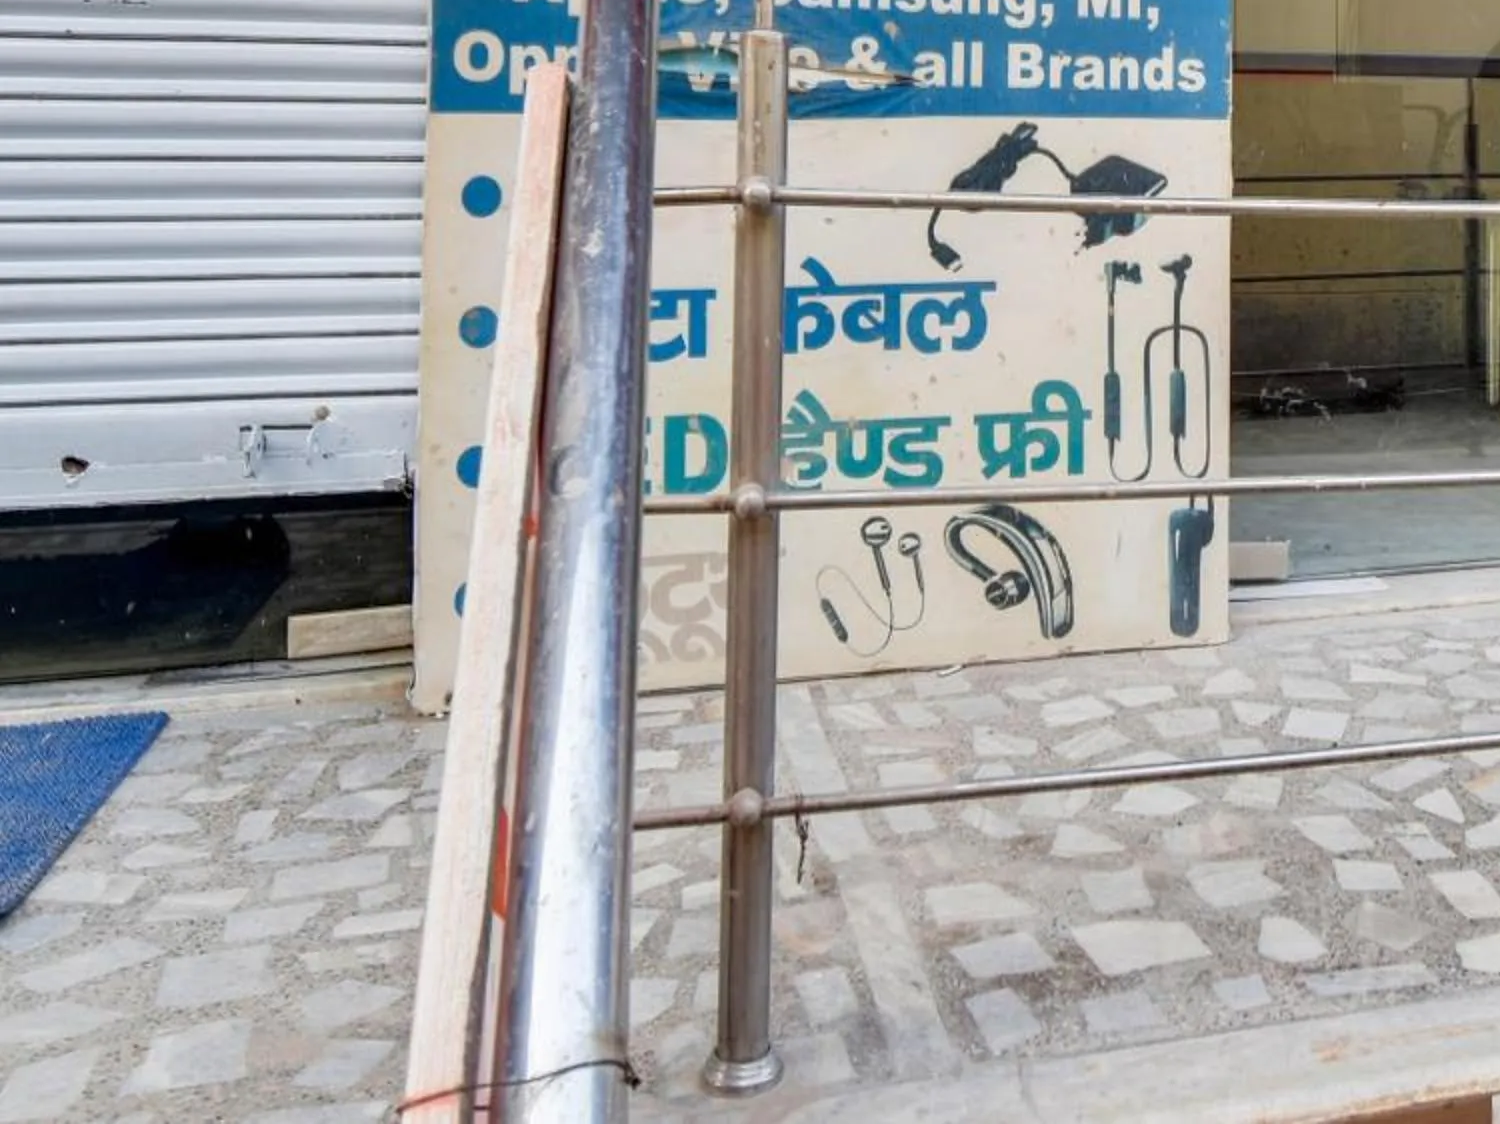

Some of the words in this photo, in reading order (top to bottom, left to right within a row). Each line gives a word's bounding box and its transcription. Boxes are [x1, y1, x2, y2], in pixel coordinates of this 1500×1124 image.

[911, 40, 984, 89] all
[1006, 41, 1207, 93] Brands
[974, 379, 1093, 480] फ्री
